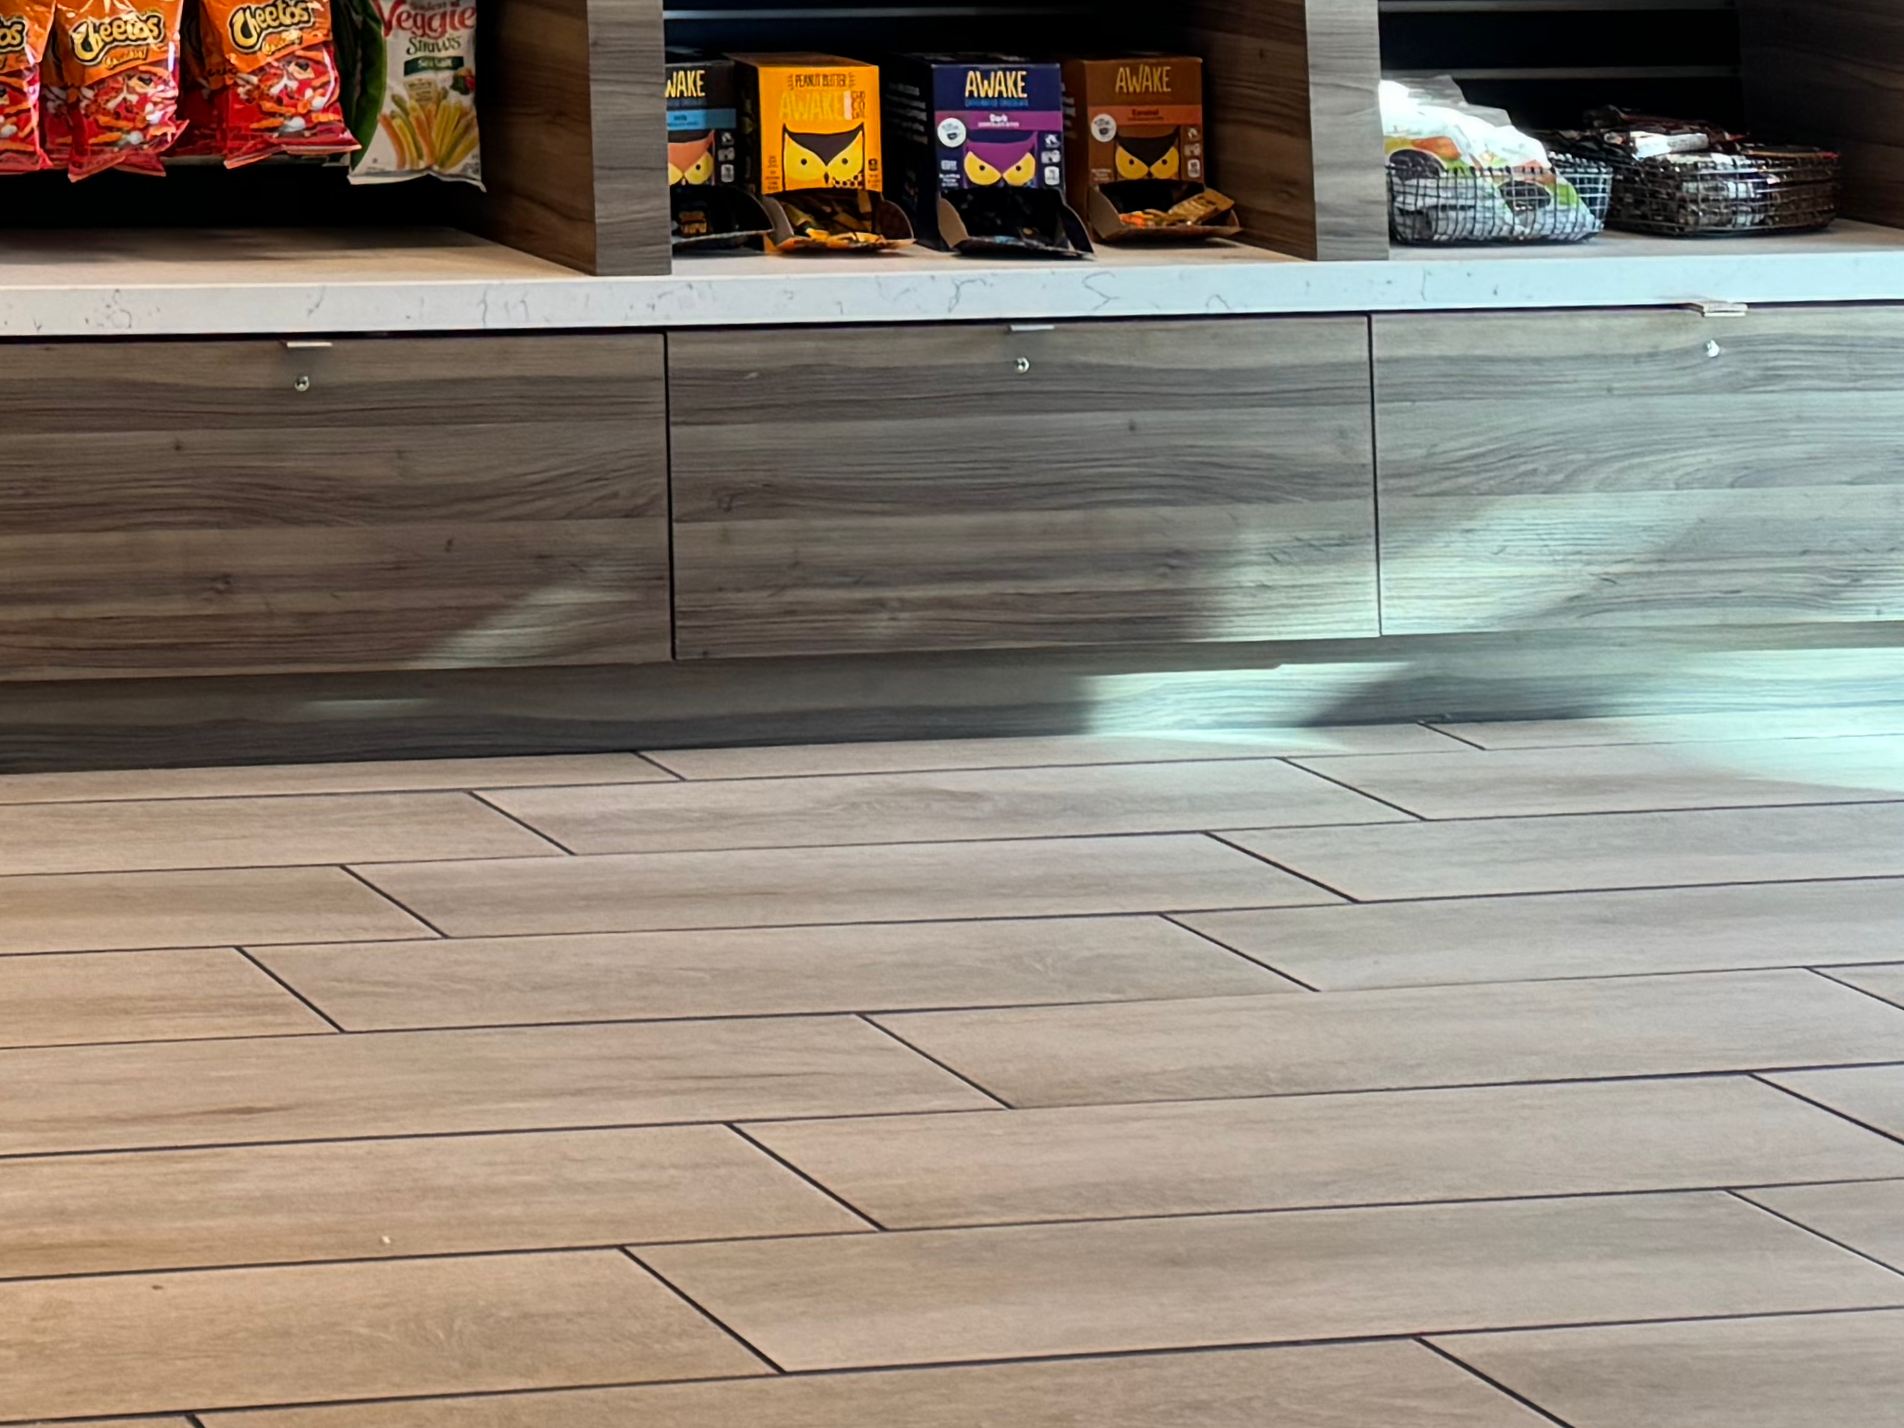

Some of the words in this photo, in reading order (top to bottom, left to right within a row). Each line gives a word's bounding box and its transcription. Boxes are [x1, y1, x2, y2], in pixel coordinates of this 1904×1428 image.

[73, 12, 163, 64] Cheetos
[665, 69, 706, 98] WAKE
[794, 73, 821, 89] PEANUT
[822, 74, 847, 88] BUTTER
[965, 70, 1028, 99] AWAKE
[1115, 65, 1171, 93] AWAKE
[778, 92, 844, 121] AWAKE
